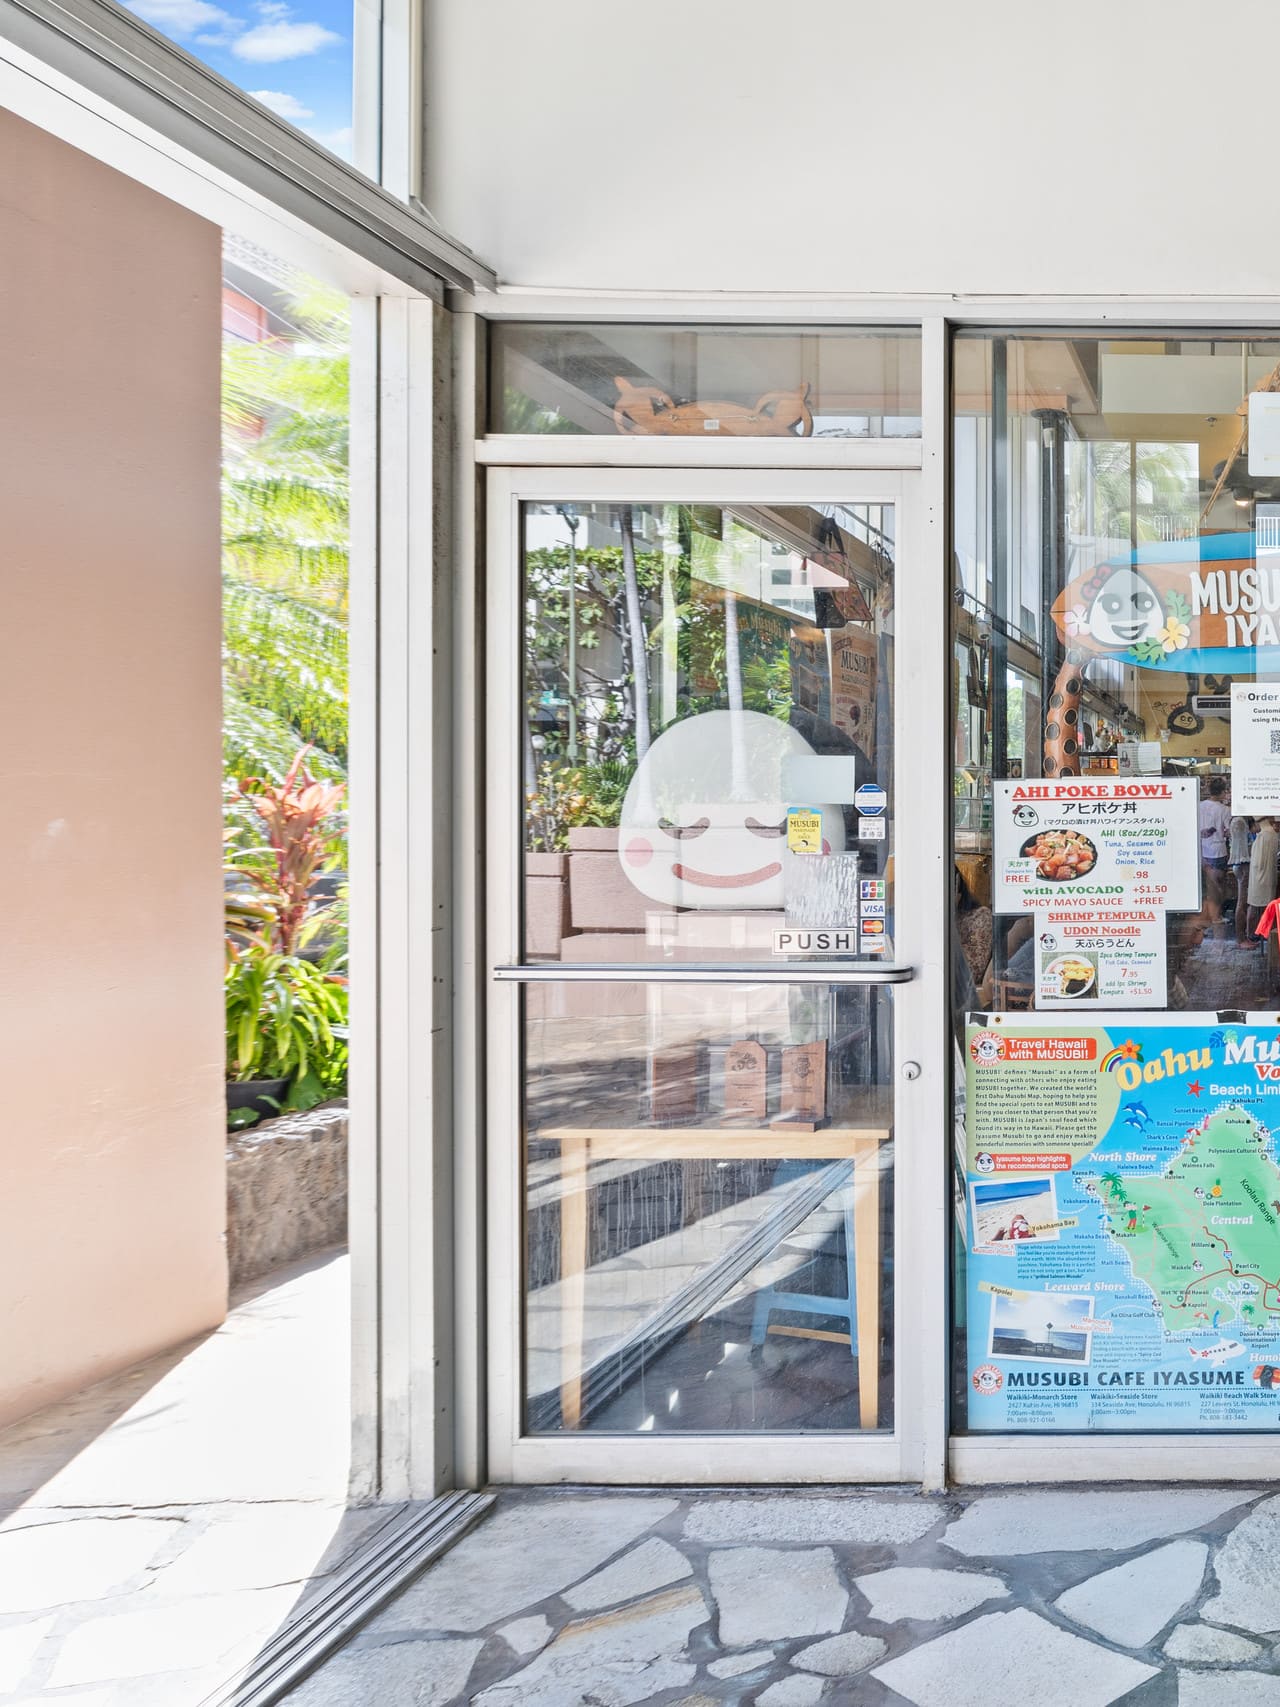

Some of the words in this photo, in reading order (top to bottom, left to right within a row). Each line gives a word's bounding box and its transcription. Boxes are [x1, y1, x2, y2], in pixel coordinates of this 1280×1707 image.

[1247, 692, 1278, 701] Order
[1013, 785, 1049, 798] AHI
[1055, 785, 1108, 797] POKE
[1114, 784, 1172, 797] BOWL
[1062, 802, 1137, 815] アヒポケ丼
[790, 820, 819, 828] MUSUBI
[1101, 829, 1115, 837] AHI
[1119, 829, 1168, 838] (8oz/220g)
[1104, 840, 1124, 848] Tuna,
[1117, 850, 1130, 858] Soy
[1006, 875, 1030, 883] FREE
[1023, 886, 1053, 895] with
[1057, 886, 1124, 895] AVOCADO
[1132, 884, 1168, 894] +$1.50
[1023, 898, 1051, 907] SPICY
[1054, 898, 1087, 906] MAYO
[1090, 897, 1123, 906] SAUCE
[1133, 897, 1164, 905] +FREE
[864, 905, 884, 913] VISA
[1048, 912, 1094, 921] SHRIMP
[1097, 911, 1156, 920] TEMPURA
[1063, 926, 1099, 935] UDON
[1102, 926, 1141, 935] Noodle
[779, 933, 849, 949] PUSH
[1075, 938, 1135, 948] 天ぷらうどん
[1009, 1040, 1045, 1049] Travel
[1049, 1040, 1087, 1049] Hawaii
[1009, 1050, 1033, 1059] with
[1037, 1050, 1089, 1059] MUSUBI!
[1116, 1047, 1213, 1091] Oahu
[1209, 1084, 1252, 1096] Beach
[1089, 1152, 1122, 1162] North
[1125, 1152, 1156, 1162] Shore
[1240, 1178, 1265, 1205] Koolau
[1257, 1201, 1276, 1226] Range
[1211, 1215, 1254, 1225] Central
[1032, 1221, 1063, 1232] Yokohama
[1063, 1220, 1075, 1228] Bay
[990, 1286, 1012, 1296] Kapolei
[1045, 1282, 1090, 1291] Leeward
[1094, 1282, 1125, 1291] Shore
[1007, 1372, 1089, 1387] MUSUBI
[1097, 1371, 1145, 1386] CAFE
[1153, 1371, 1245, 1386] IYASUME
